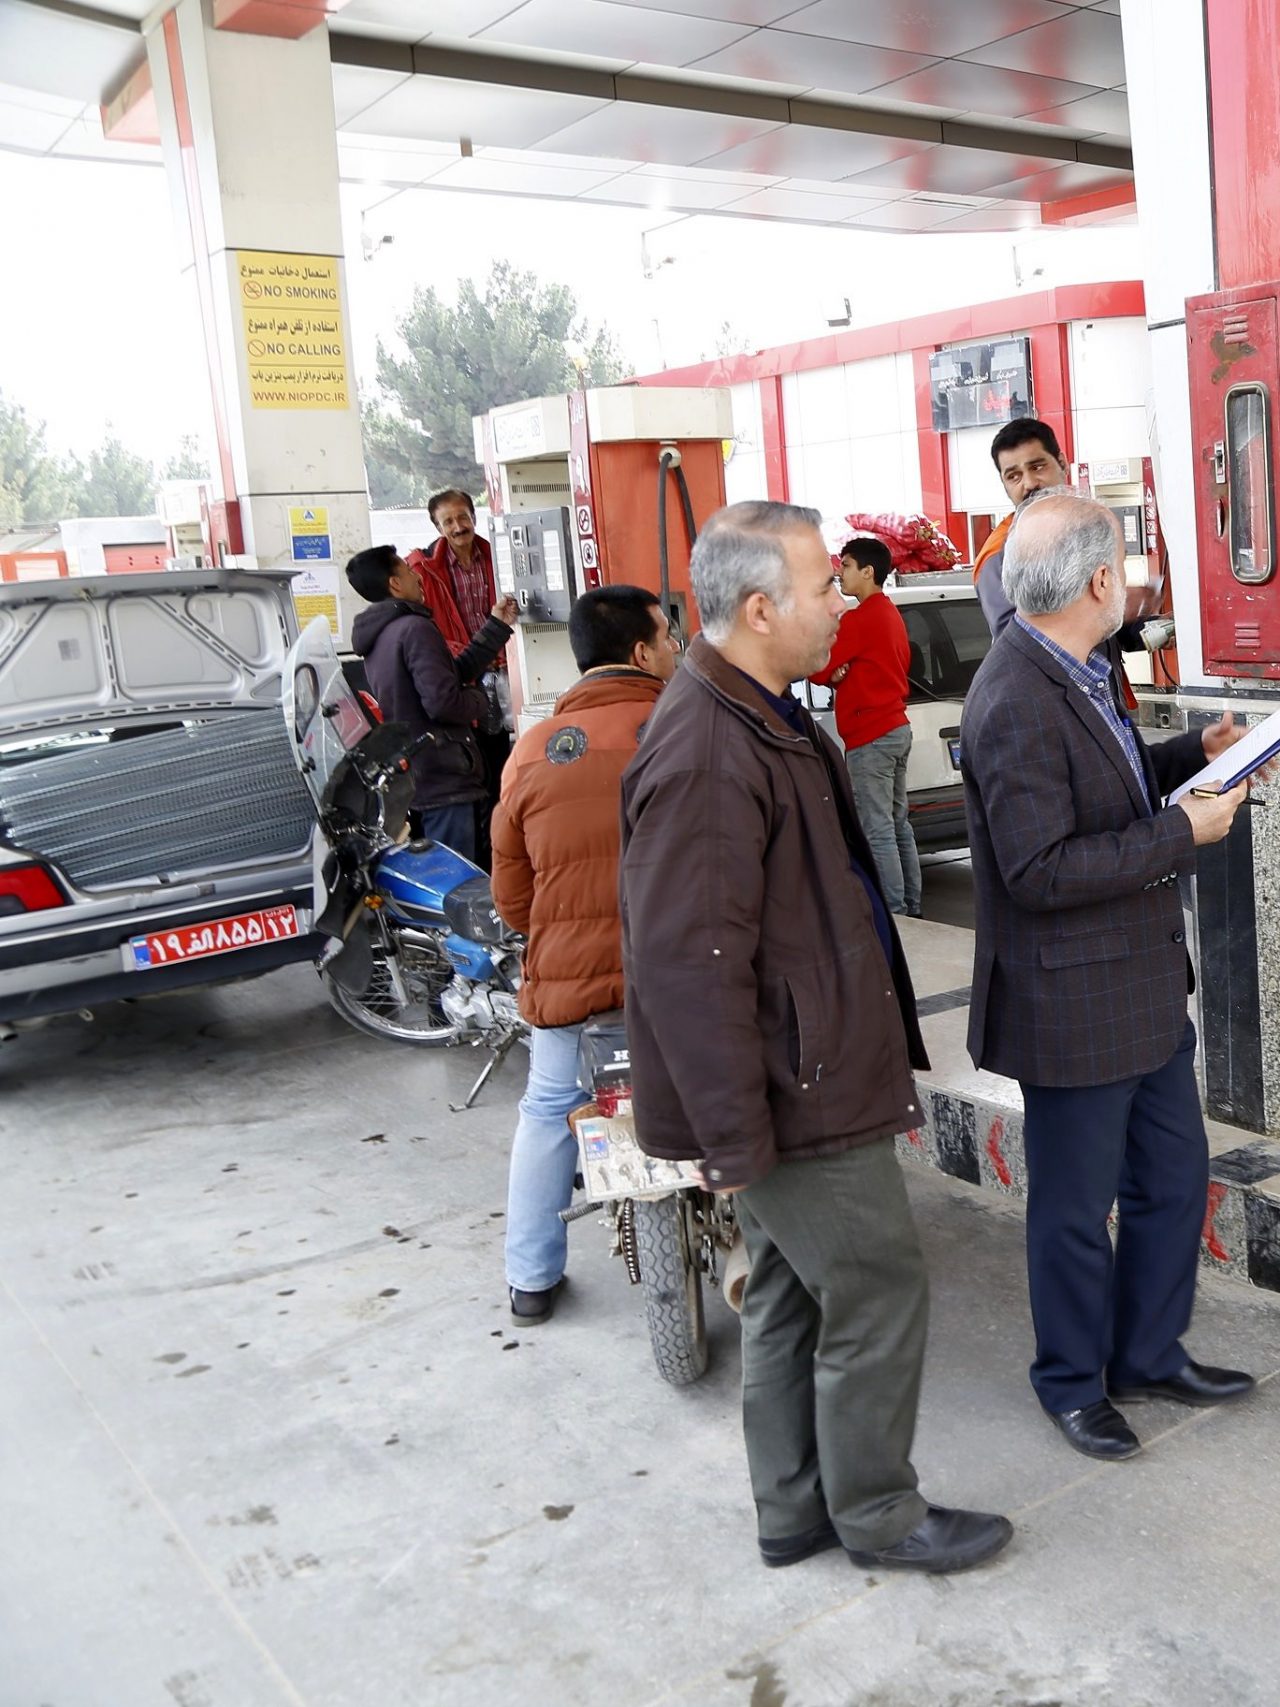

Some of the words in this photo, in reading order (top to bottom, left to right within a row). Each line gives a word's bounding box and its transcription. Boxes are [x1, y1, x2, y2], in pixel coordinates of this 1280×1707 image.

[240, 263, 264, 278] ممنوع
[268, 264, 300, 278] دخانیات
[301, 267, 331, 281] استعمال
[264, 285, 282, 297] NO
[286, 286, 337, 300] SMOKING
[248, 318, 268, 334] ممنوع
[312, 322, 338, 334] استفاده
[267, 343, 285, 354] NO
[288, 344, 341, 356] CALLING
[252, 391, 345, 402] WWW.NIOPDC.IR
[266, 913, 294, 938] ۱۲
[152, 933, 186, 962] ۱۹
[216, 916, 263, 951] ۸۵۵
